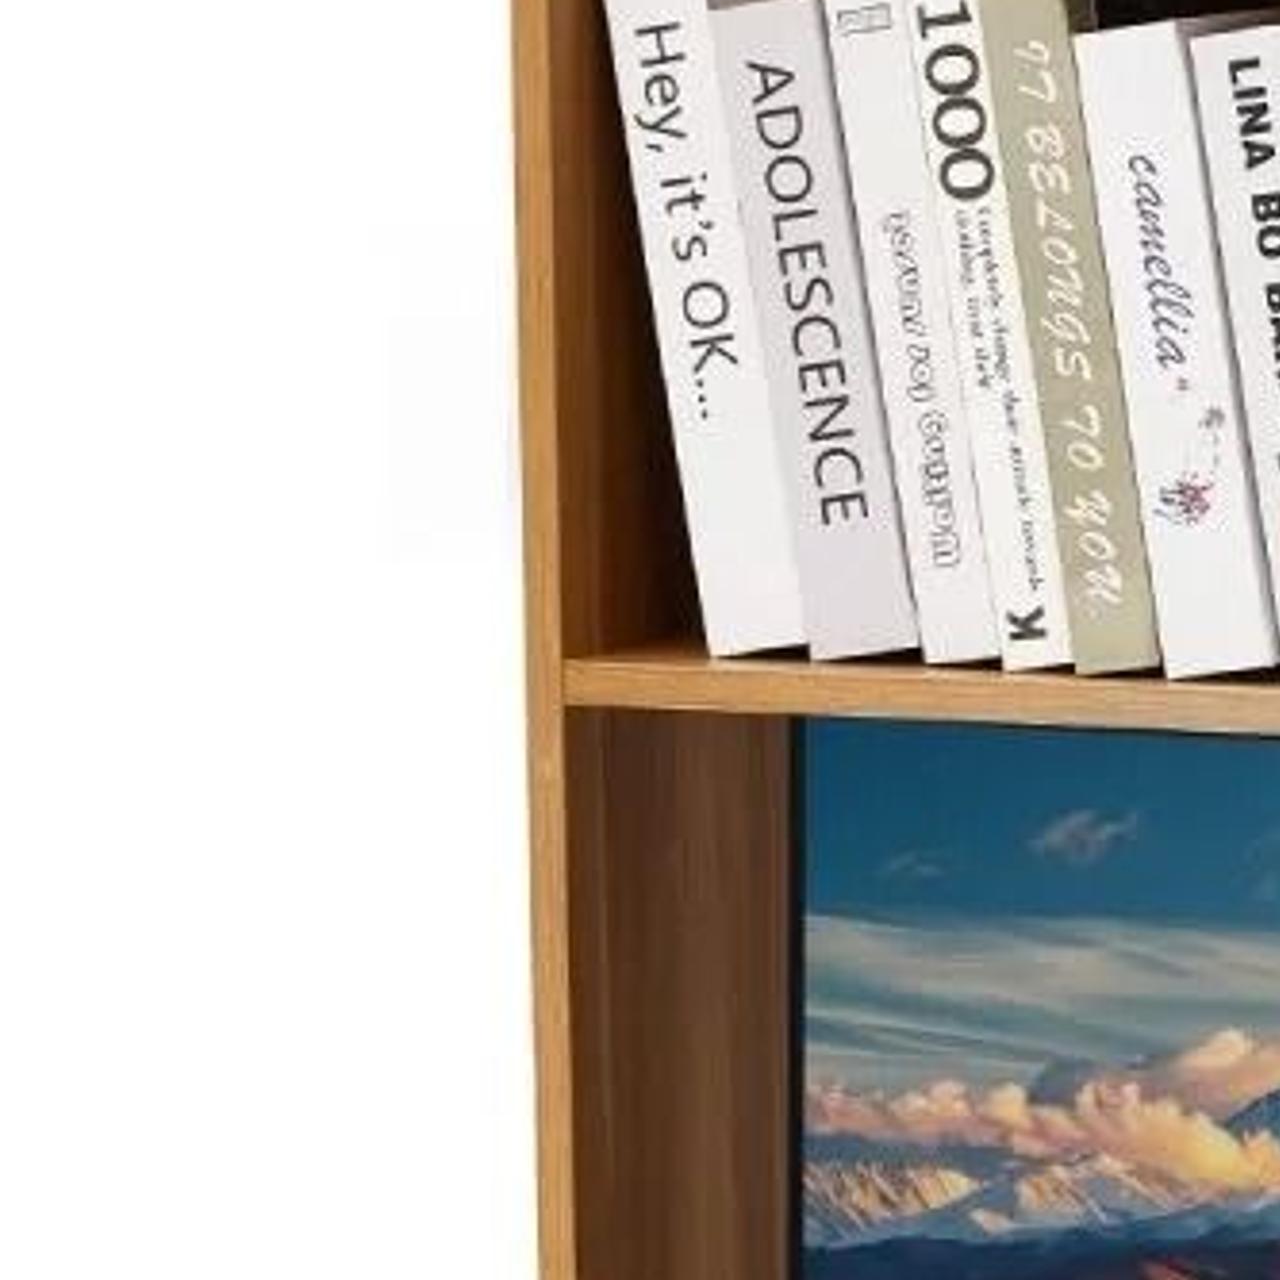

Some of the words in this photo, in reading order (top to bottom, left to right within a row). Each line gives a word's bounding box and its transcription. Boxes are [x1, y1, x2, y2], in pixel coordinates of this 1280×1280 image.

[633, 19, 688, 156] Hey,
[661, 172, 710, 263] it's
[1227, 55, 1276, 171] LINA
[745, 58, 869, 527] ADOLESCENCE
